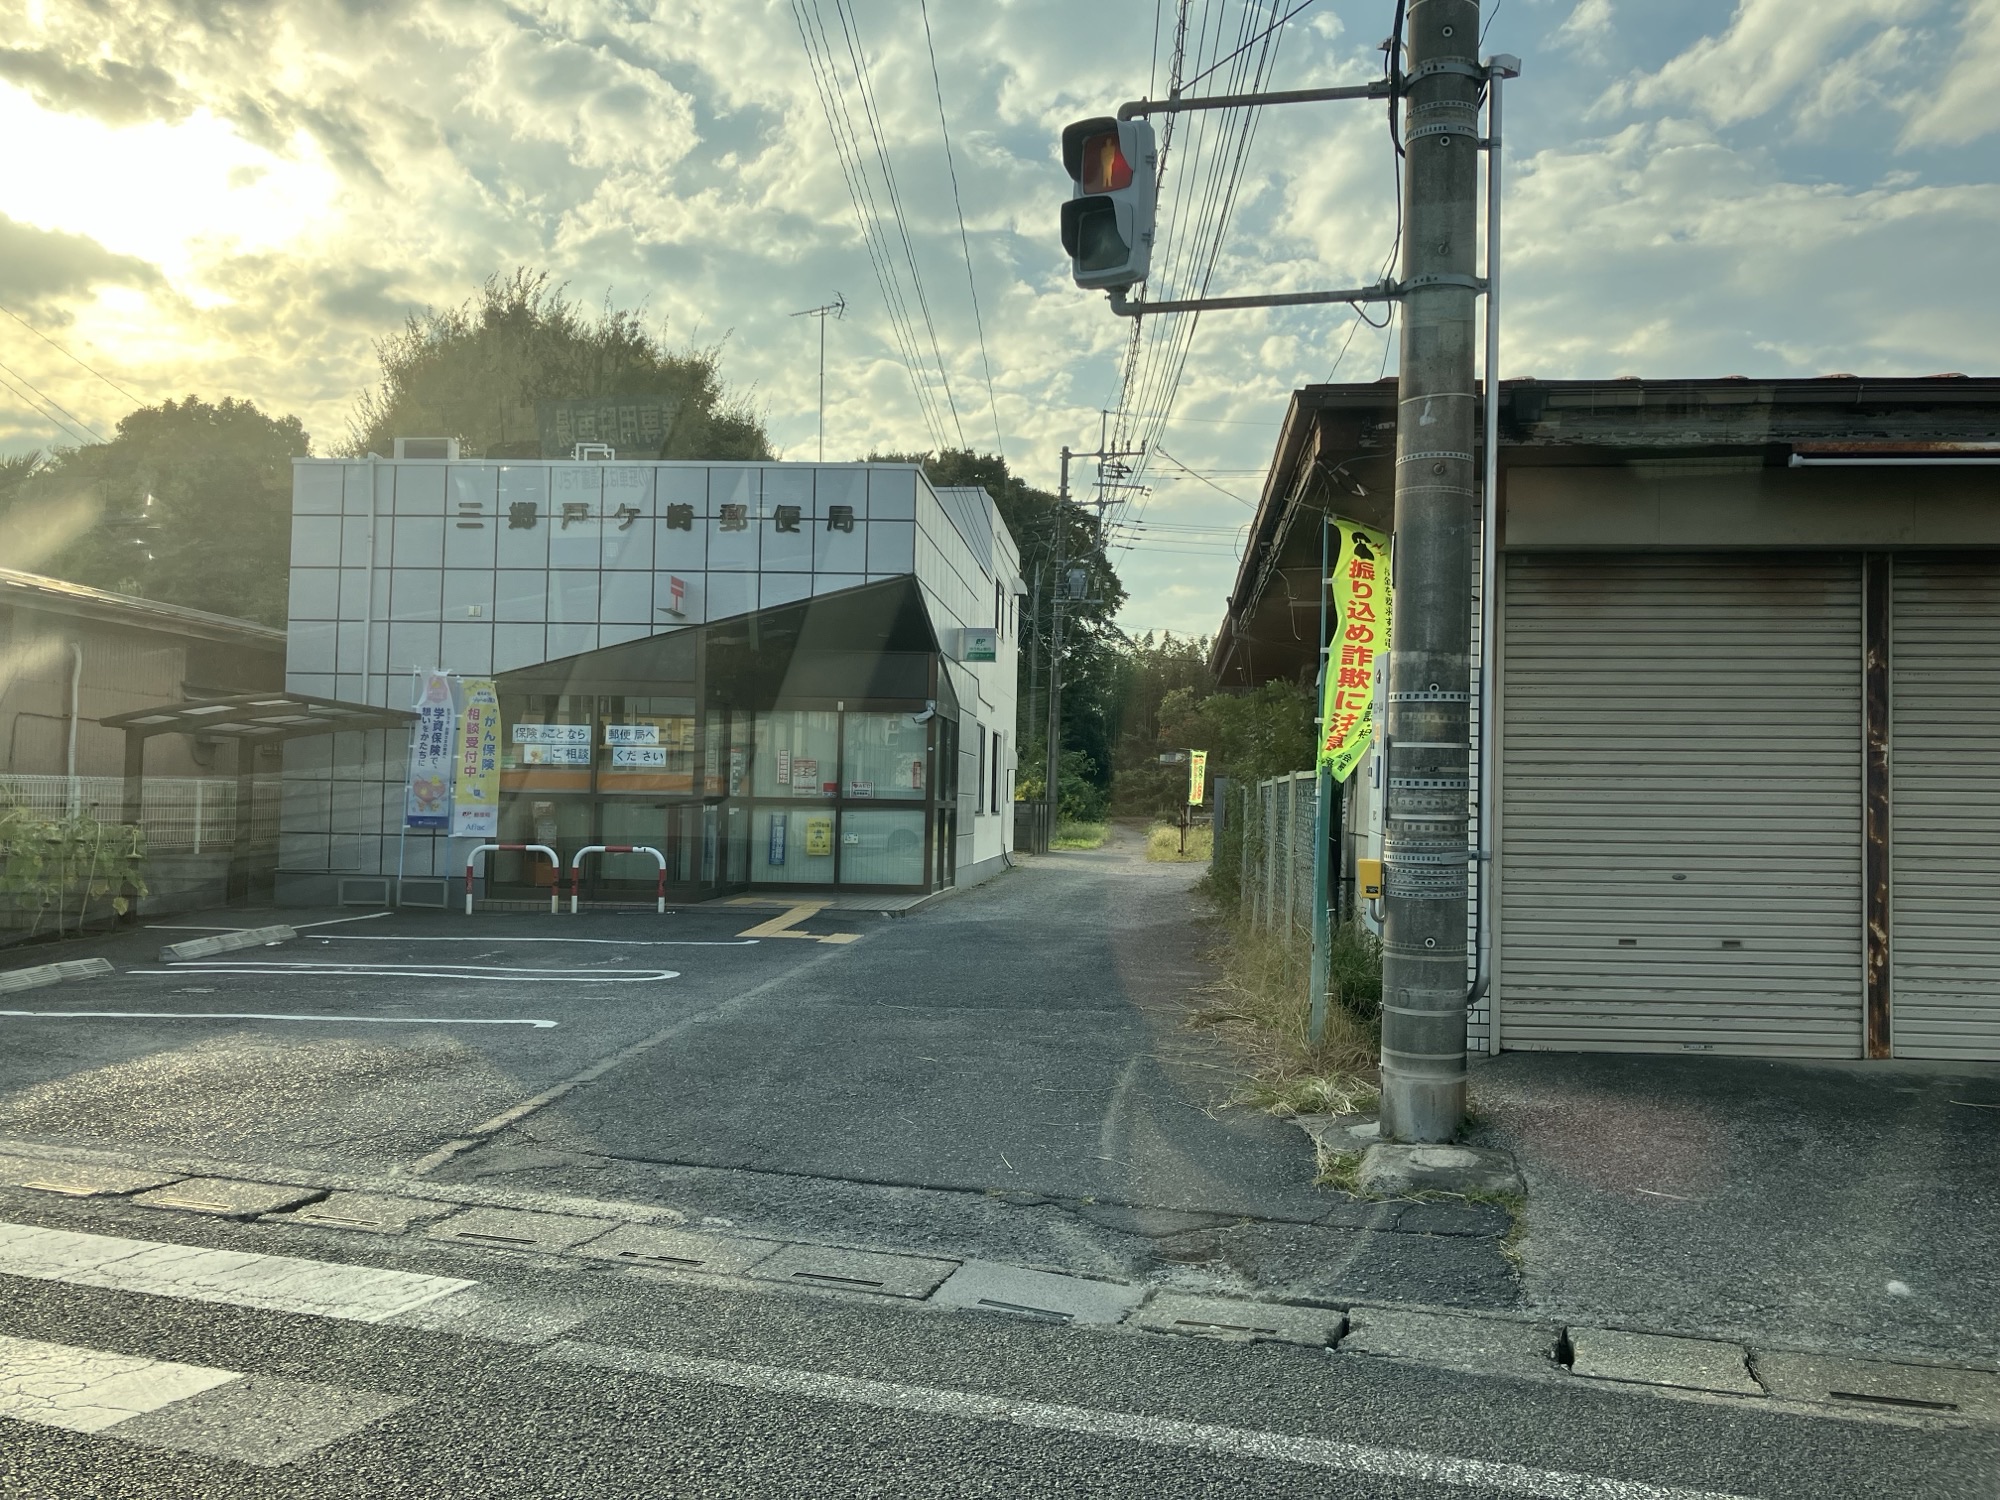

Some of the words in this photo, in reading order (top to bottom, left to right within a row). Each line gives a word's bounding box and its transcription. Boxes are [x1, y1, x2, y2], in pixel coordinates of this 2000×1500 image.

[1326, 559, 1376, 751] 振り込め詐欺に注意
[418, 706, 432, 767] 想いをかたちに
[430, 707, 446, 769] 学資保険で、
[464, 707, 481, 778] 相談受付中
[515, 727, 586, 741] 保険のことなら
[608, 728, 656, 741] 郵便局へ
[553, 748, 590, 760] ご相談
[616, 750, 664, 762] ください
